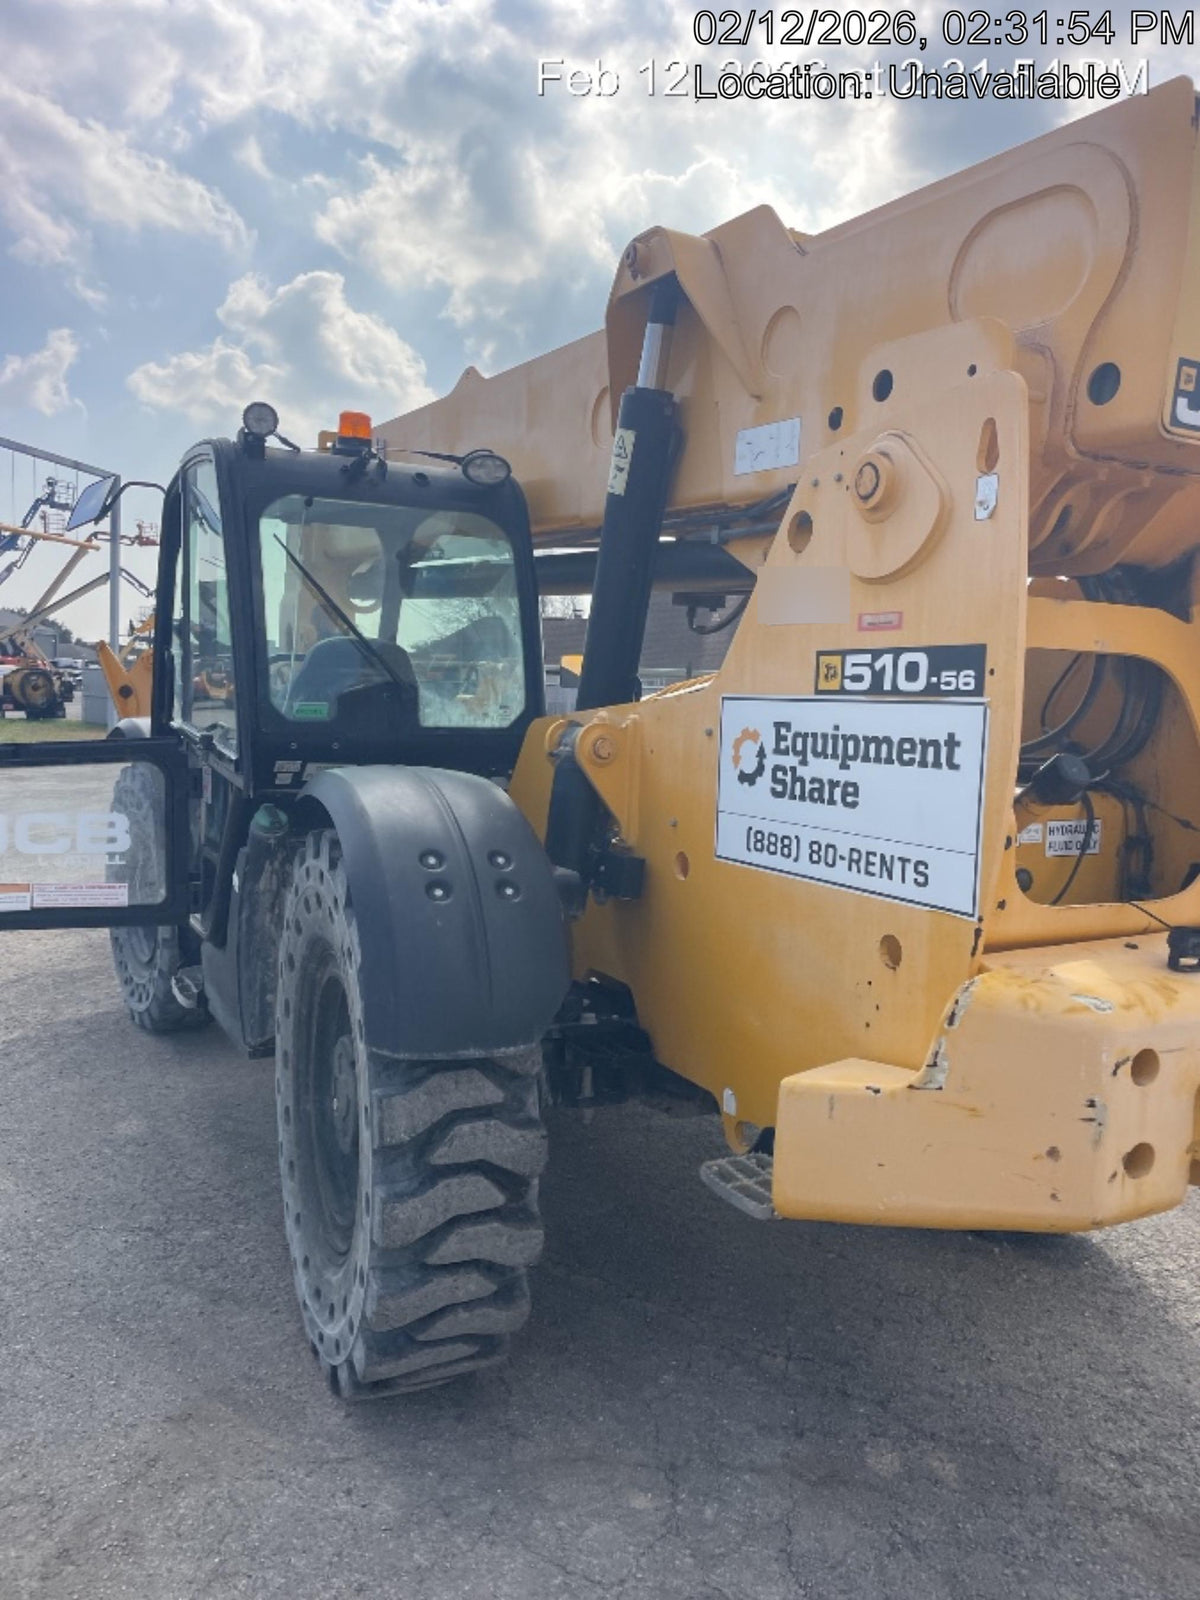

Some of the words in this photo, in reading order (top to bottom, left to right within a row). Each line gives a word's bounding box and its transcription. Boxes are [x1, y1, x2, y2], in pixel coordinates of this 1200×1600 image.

[772, 721, 961, 770] Equipment
[770, 764, 860, 809] Share
[0, 811, 131, 853] CB
[746, 826, 801, 863] (888)
[808, 840, 930, 888] 80-RENTS
